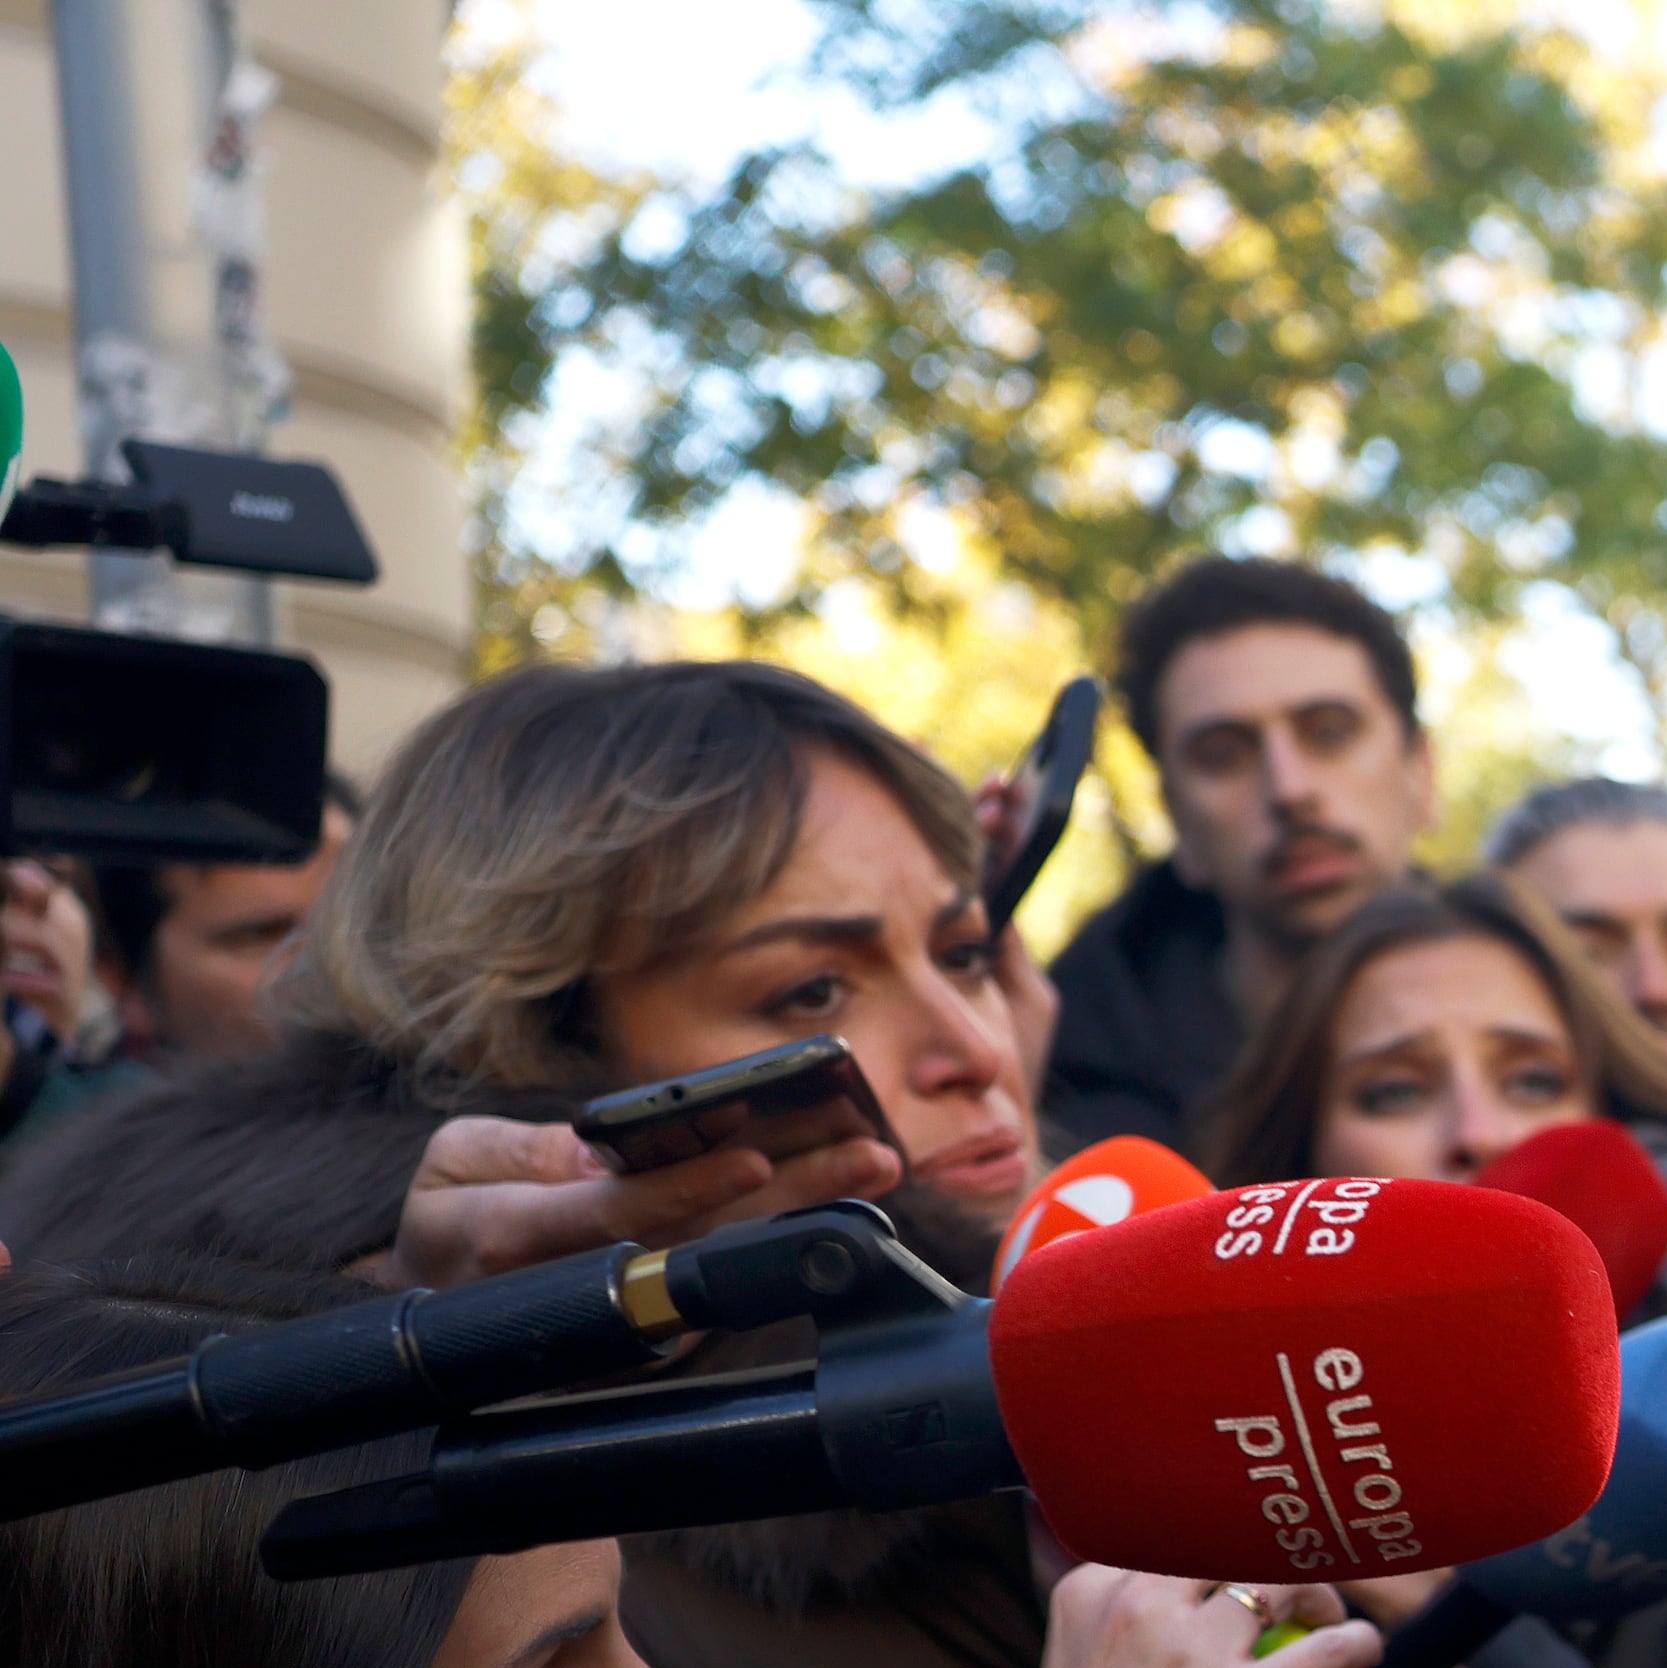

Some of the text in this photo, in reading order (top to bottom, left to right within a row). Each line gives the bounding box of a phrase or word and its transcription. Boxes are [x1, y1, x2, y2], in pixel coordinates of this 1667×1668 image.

[1215, 1181, 1300, 1259] ess
[1306, 1177, 1393, 1255] opa
[1214, 1415, 1336, 1570] press
[1313, 1346, 1422, 1562] europa
